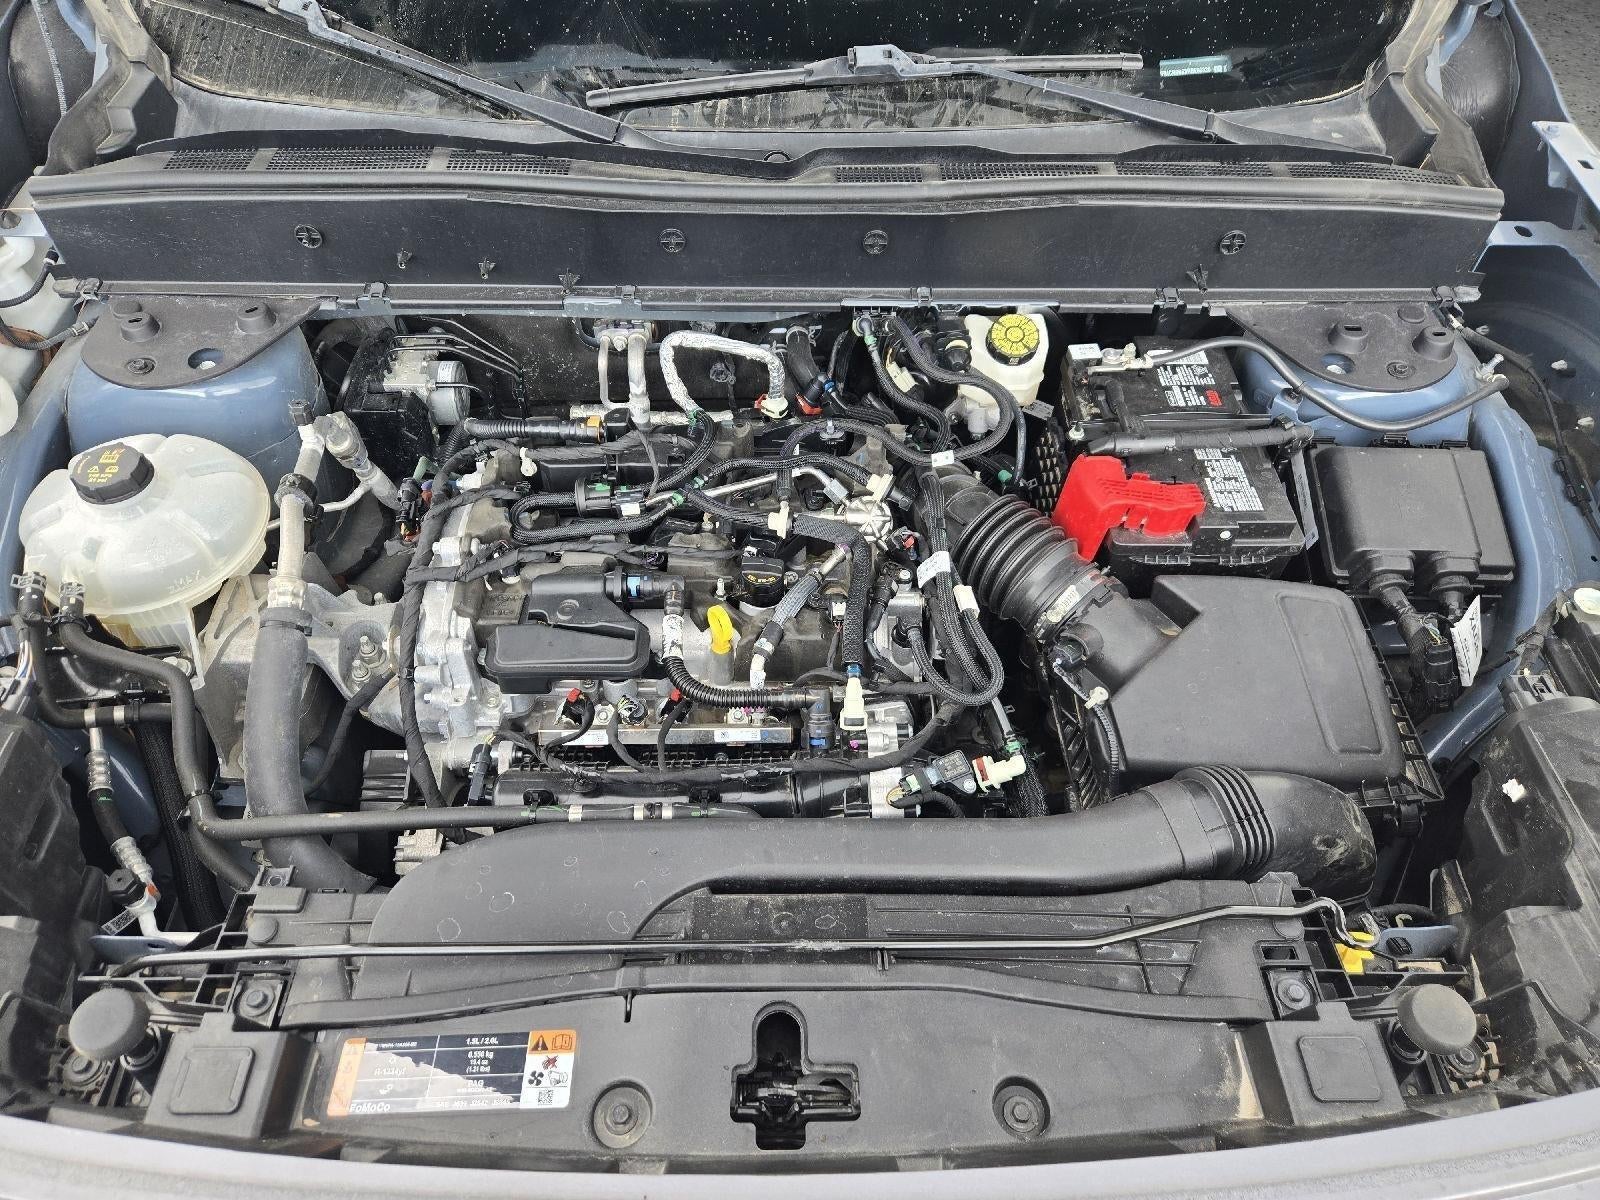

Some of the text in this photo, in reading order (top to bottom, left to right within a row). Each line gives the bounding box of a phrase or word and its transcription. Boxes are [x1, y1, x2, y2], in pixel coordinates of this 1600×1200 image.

[466, 1037, 480, 1046] 1.5L
[484, 1036, 499, 1045] 2.0L
[485, 1050, 494, 1060] kg
[349, 1101, 391, 1113] FoMoCo
